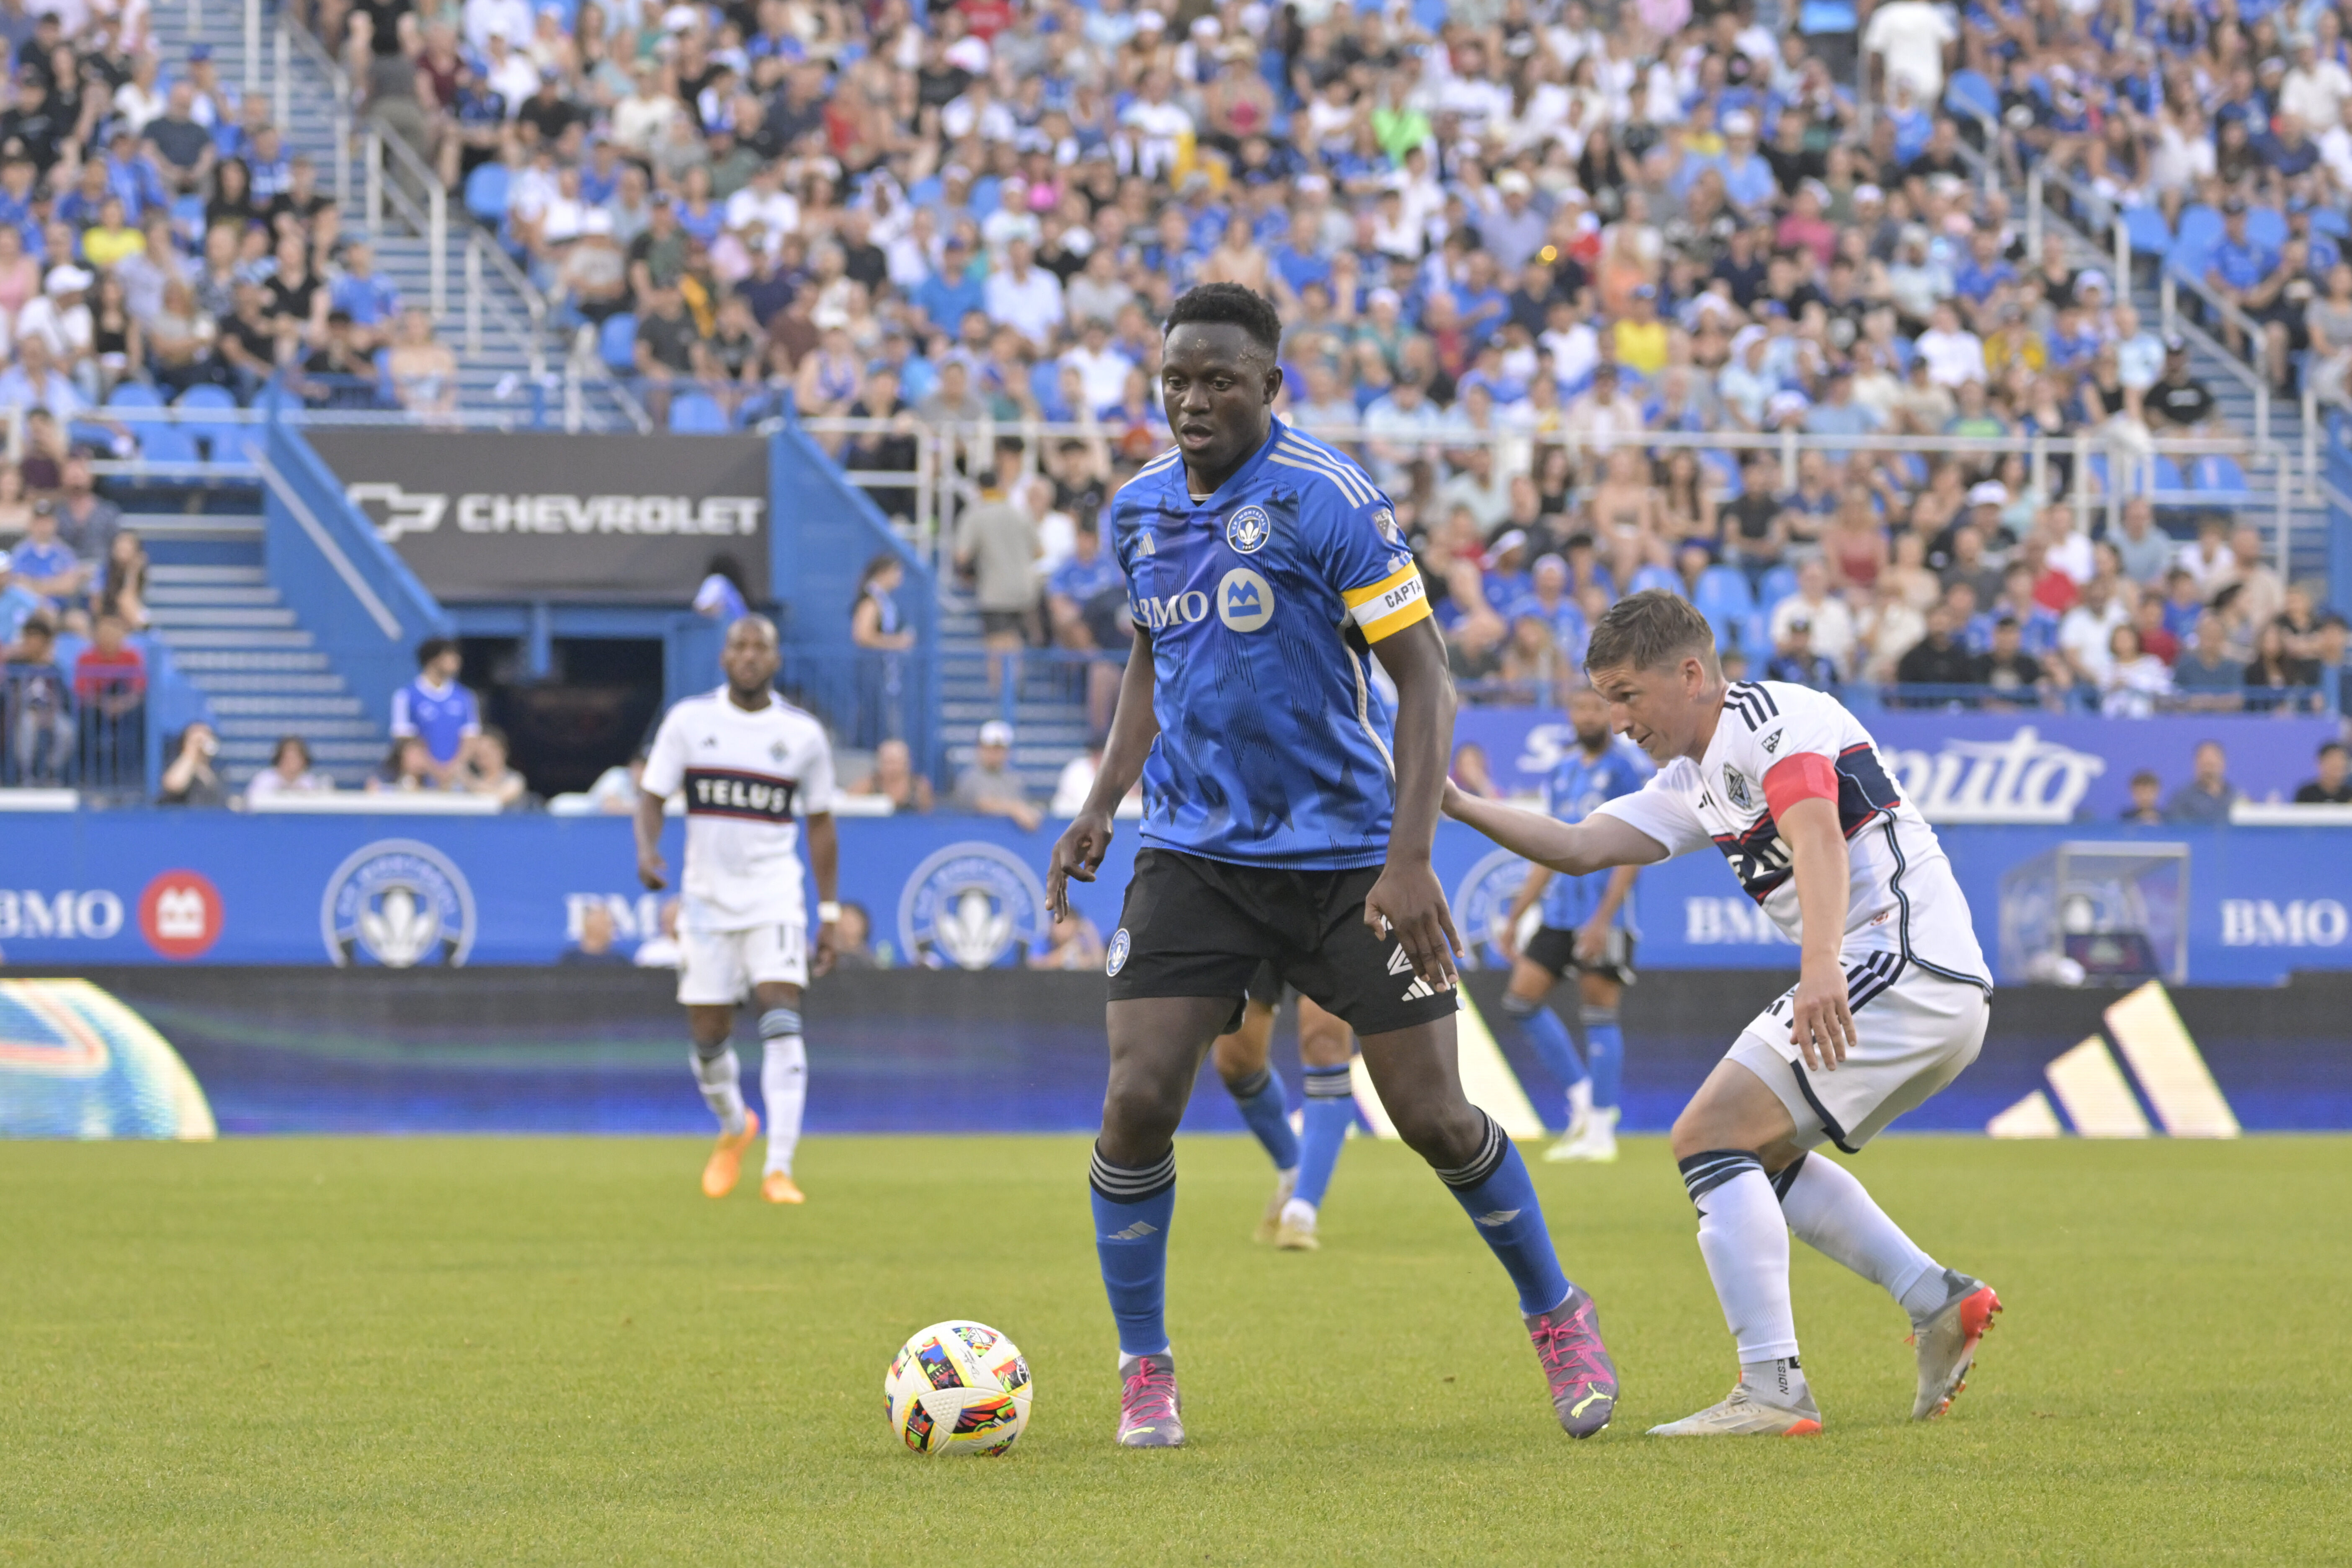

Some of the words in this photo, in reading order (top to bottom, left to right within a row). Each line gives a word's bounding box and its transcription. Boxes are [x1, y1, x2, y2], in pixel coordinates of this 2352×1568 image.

[456, 494, 763, 535] CHEVROLET
[1375, 512, 1388, 523] MLS
[1385, 579, 1422, 608] CAPTA
[1763, 733, 1779, 749] MLS
[1880, 725, 2107, 824] puto
[695, 779, 787, 814] TELUS
[1727, 836, 1794, 887] ELU
[1684, 897, 1785, 944] BM
[2221, 898, 2347, 947] BMO
[1777, 1359, 1789, 1395] ESIGN
